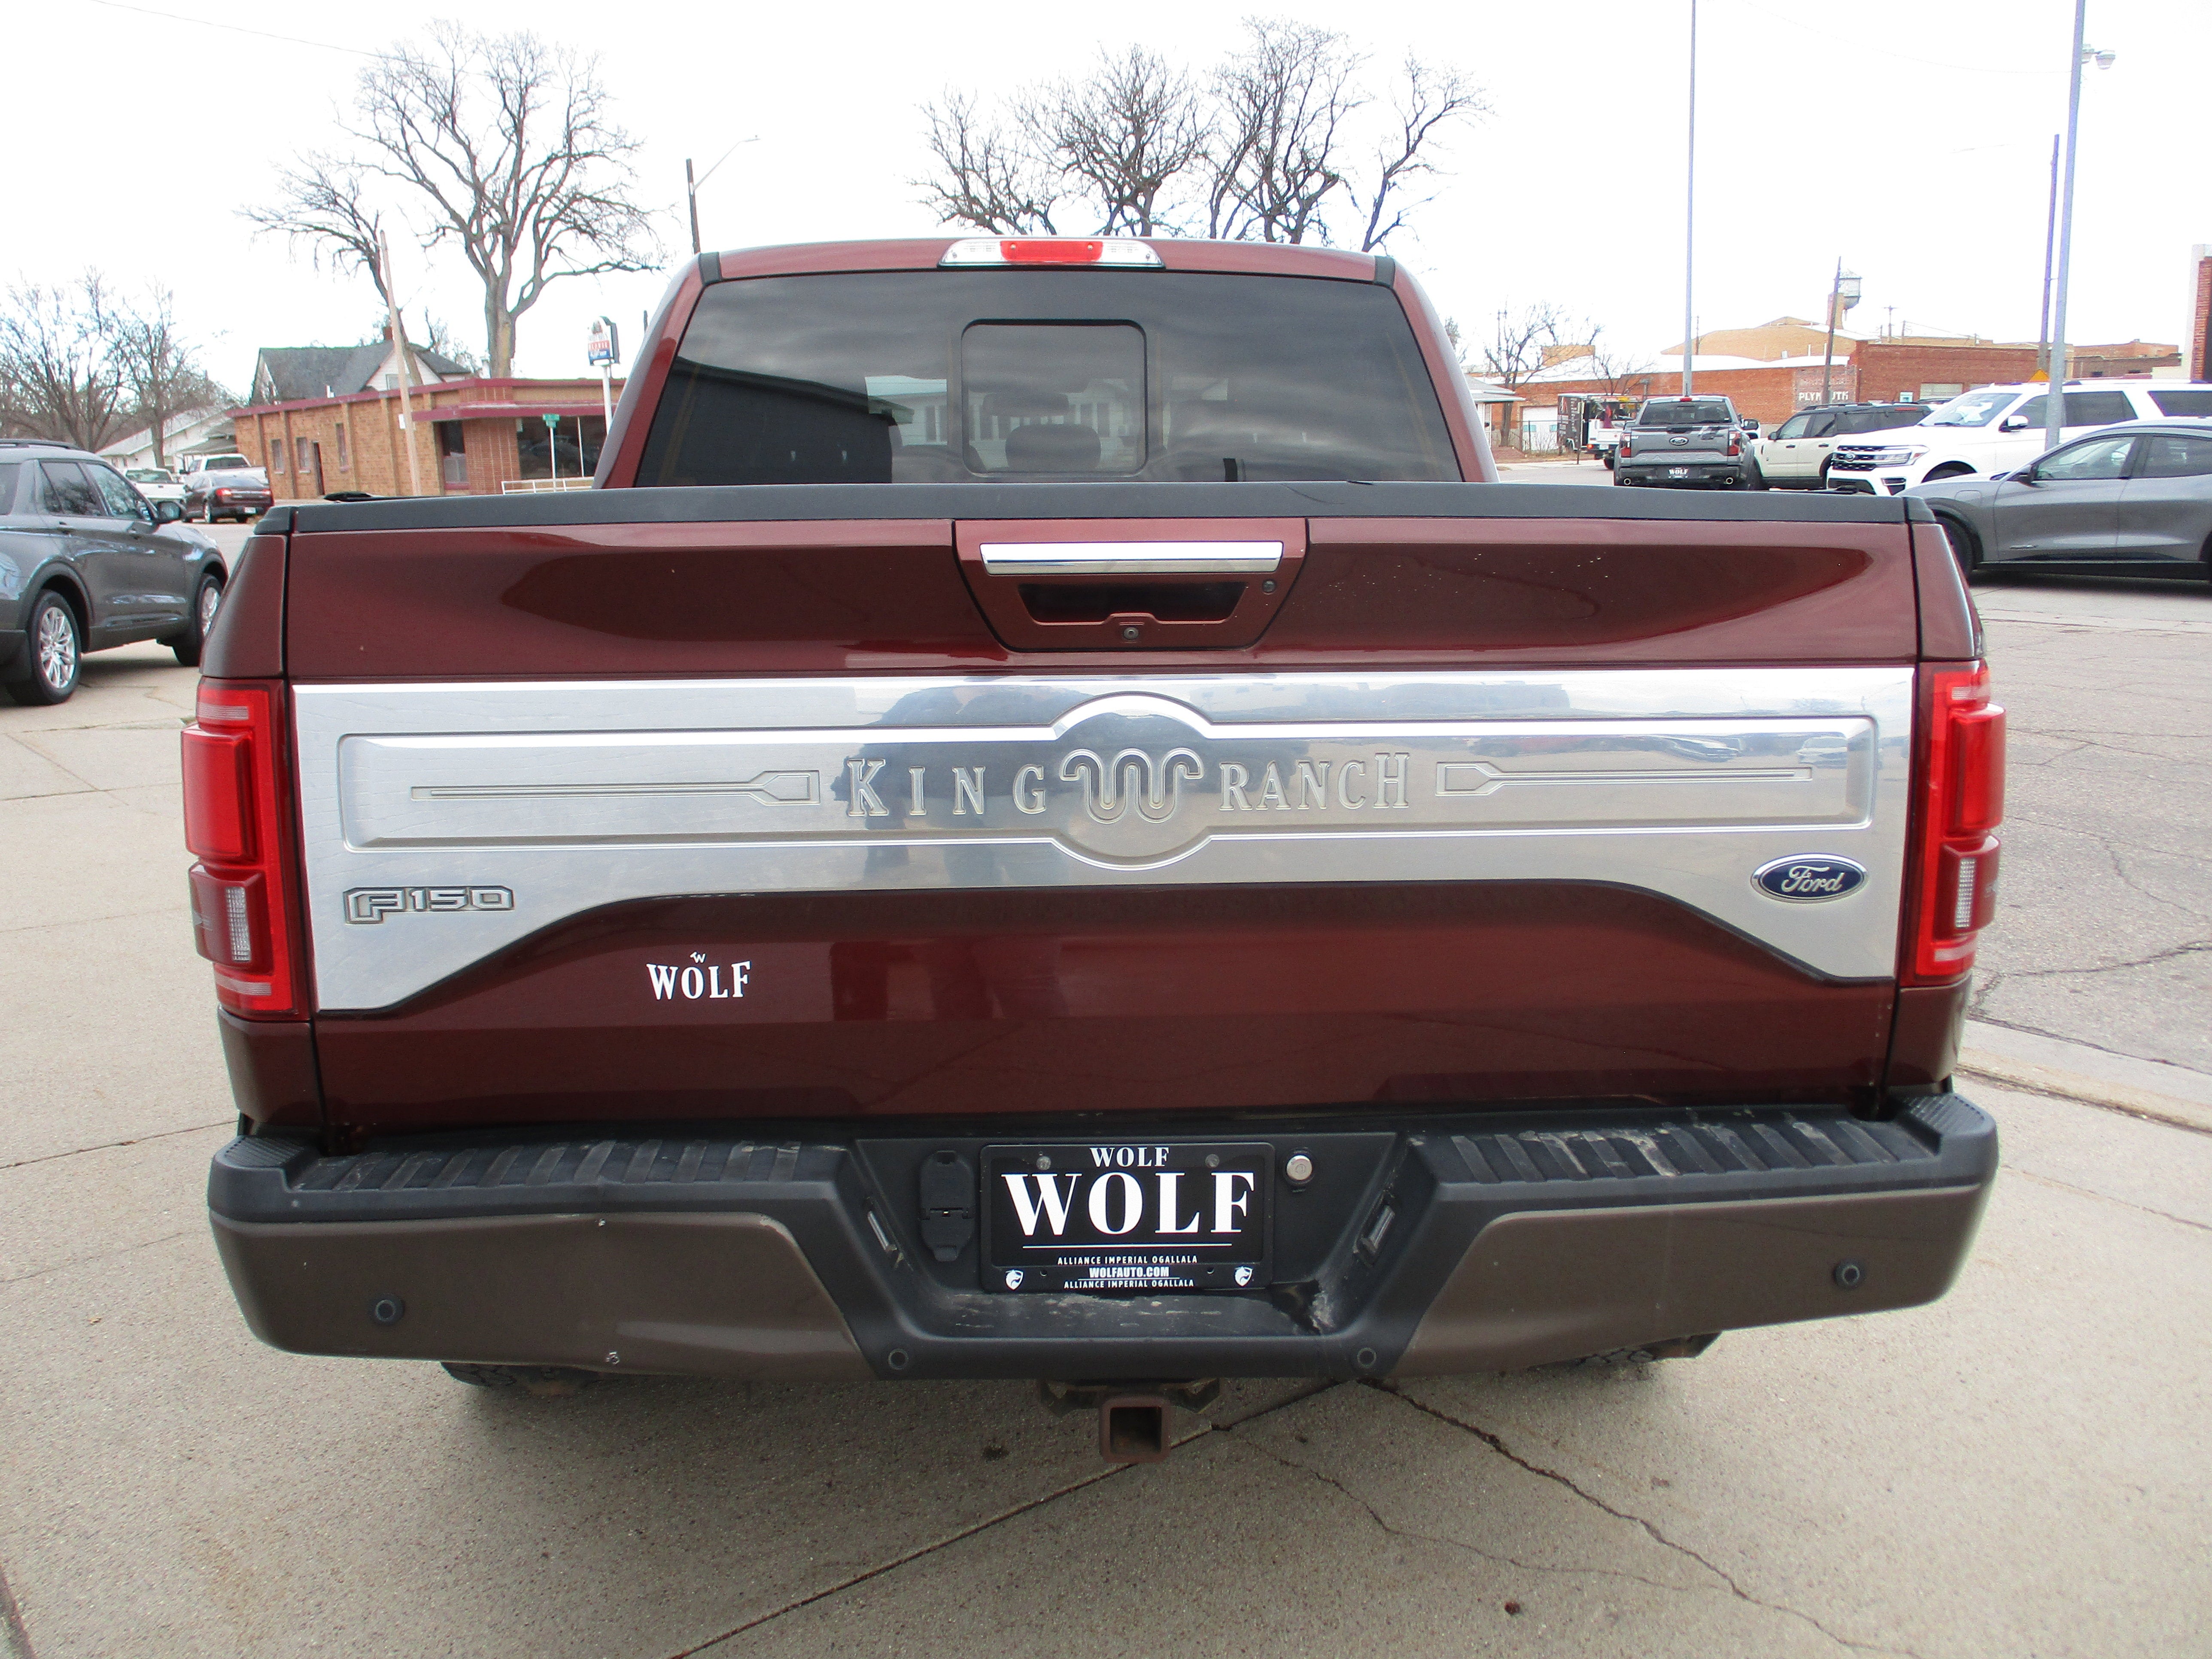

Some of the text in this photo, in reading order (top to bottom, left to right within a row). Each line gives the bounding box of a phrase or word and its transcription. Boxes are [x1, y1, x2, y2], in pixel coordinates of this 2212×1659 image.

[1799, 391, 1849, 401] PLYMUTH
[847, 752, 1410, 816] KING RANCH
[1781, 865, 1845, 893] Ford
[646, 960, 751, 1000] WOLF
[1089, 1147, 1169, 1167] WOLF
[1001, 1172, 1255, 1236] WOLF
[1057, 1255, 1198, 1265] ALLIANCE IMPERIAL OGALLALA
[1089, 1267, 1170, 1278] WOLFAUTO.COM
[1063, 1281, 1105, 1289] ALLIANCE
[1151, 1279, 1194, 1288] OGALLALA
